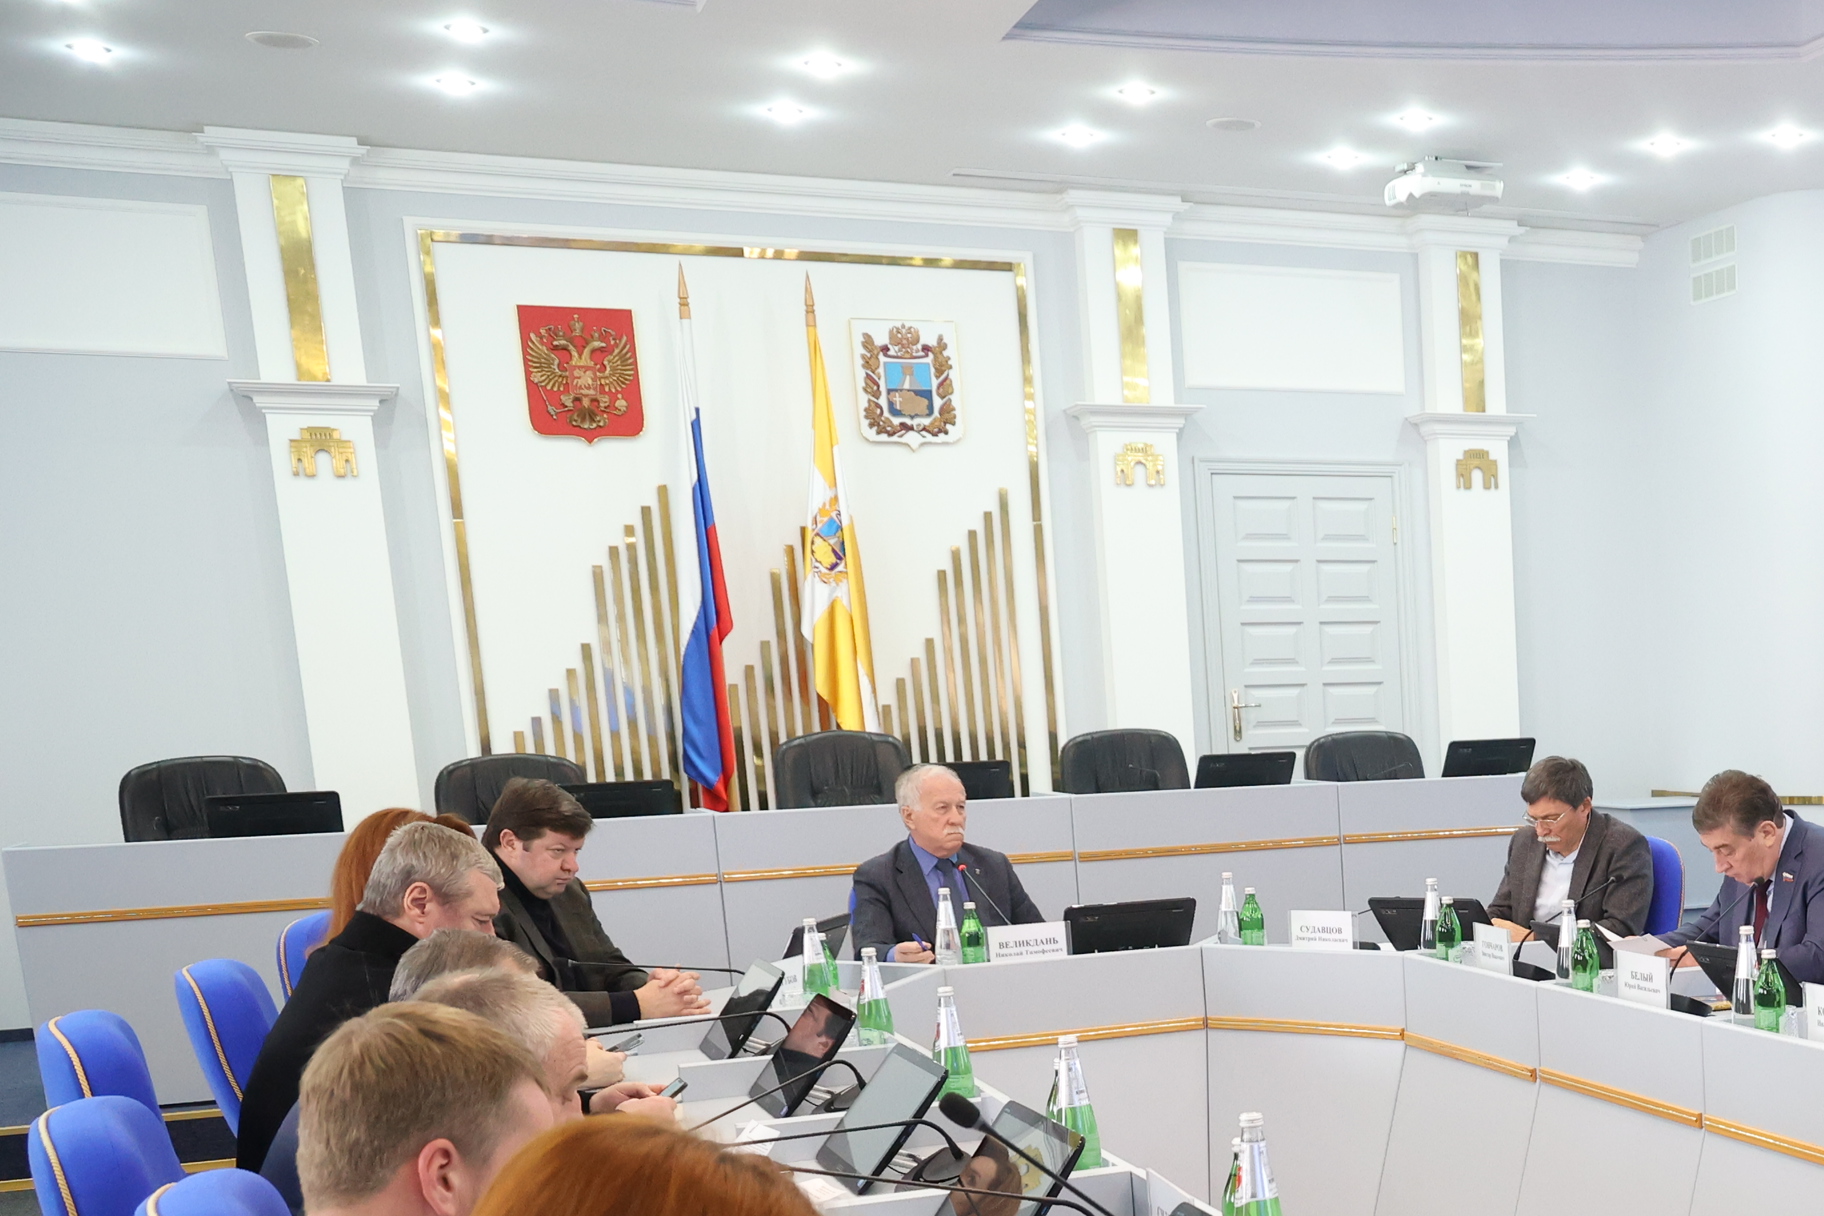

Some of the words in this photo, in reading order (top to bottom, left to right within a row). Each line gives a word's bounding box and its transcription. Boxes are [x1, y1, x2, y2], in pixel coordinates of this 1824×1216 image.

[1300, 925, 1343, 935] СУДАВЦОВ
[998, 937, 1059, 950] ВЕЛИКДАНЬ
[1630, 970, 1654, 983] БЕЛЫЙ
